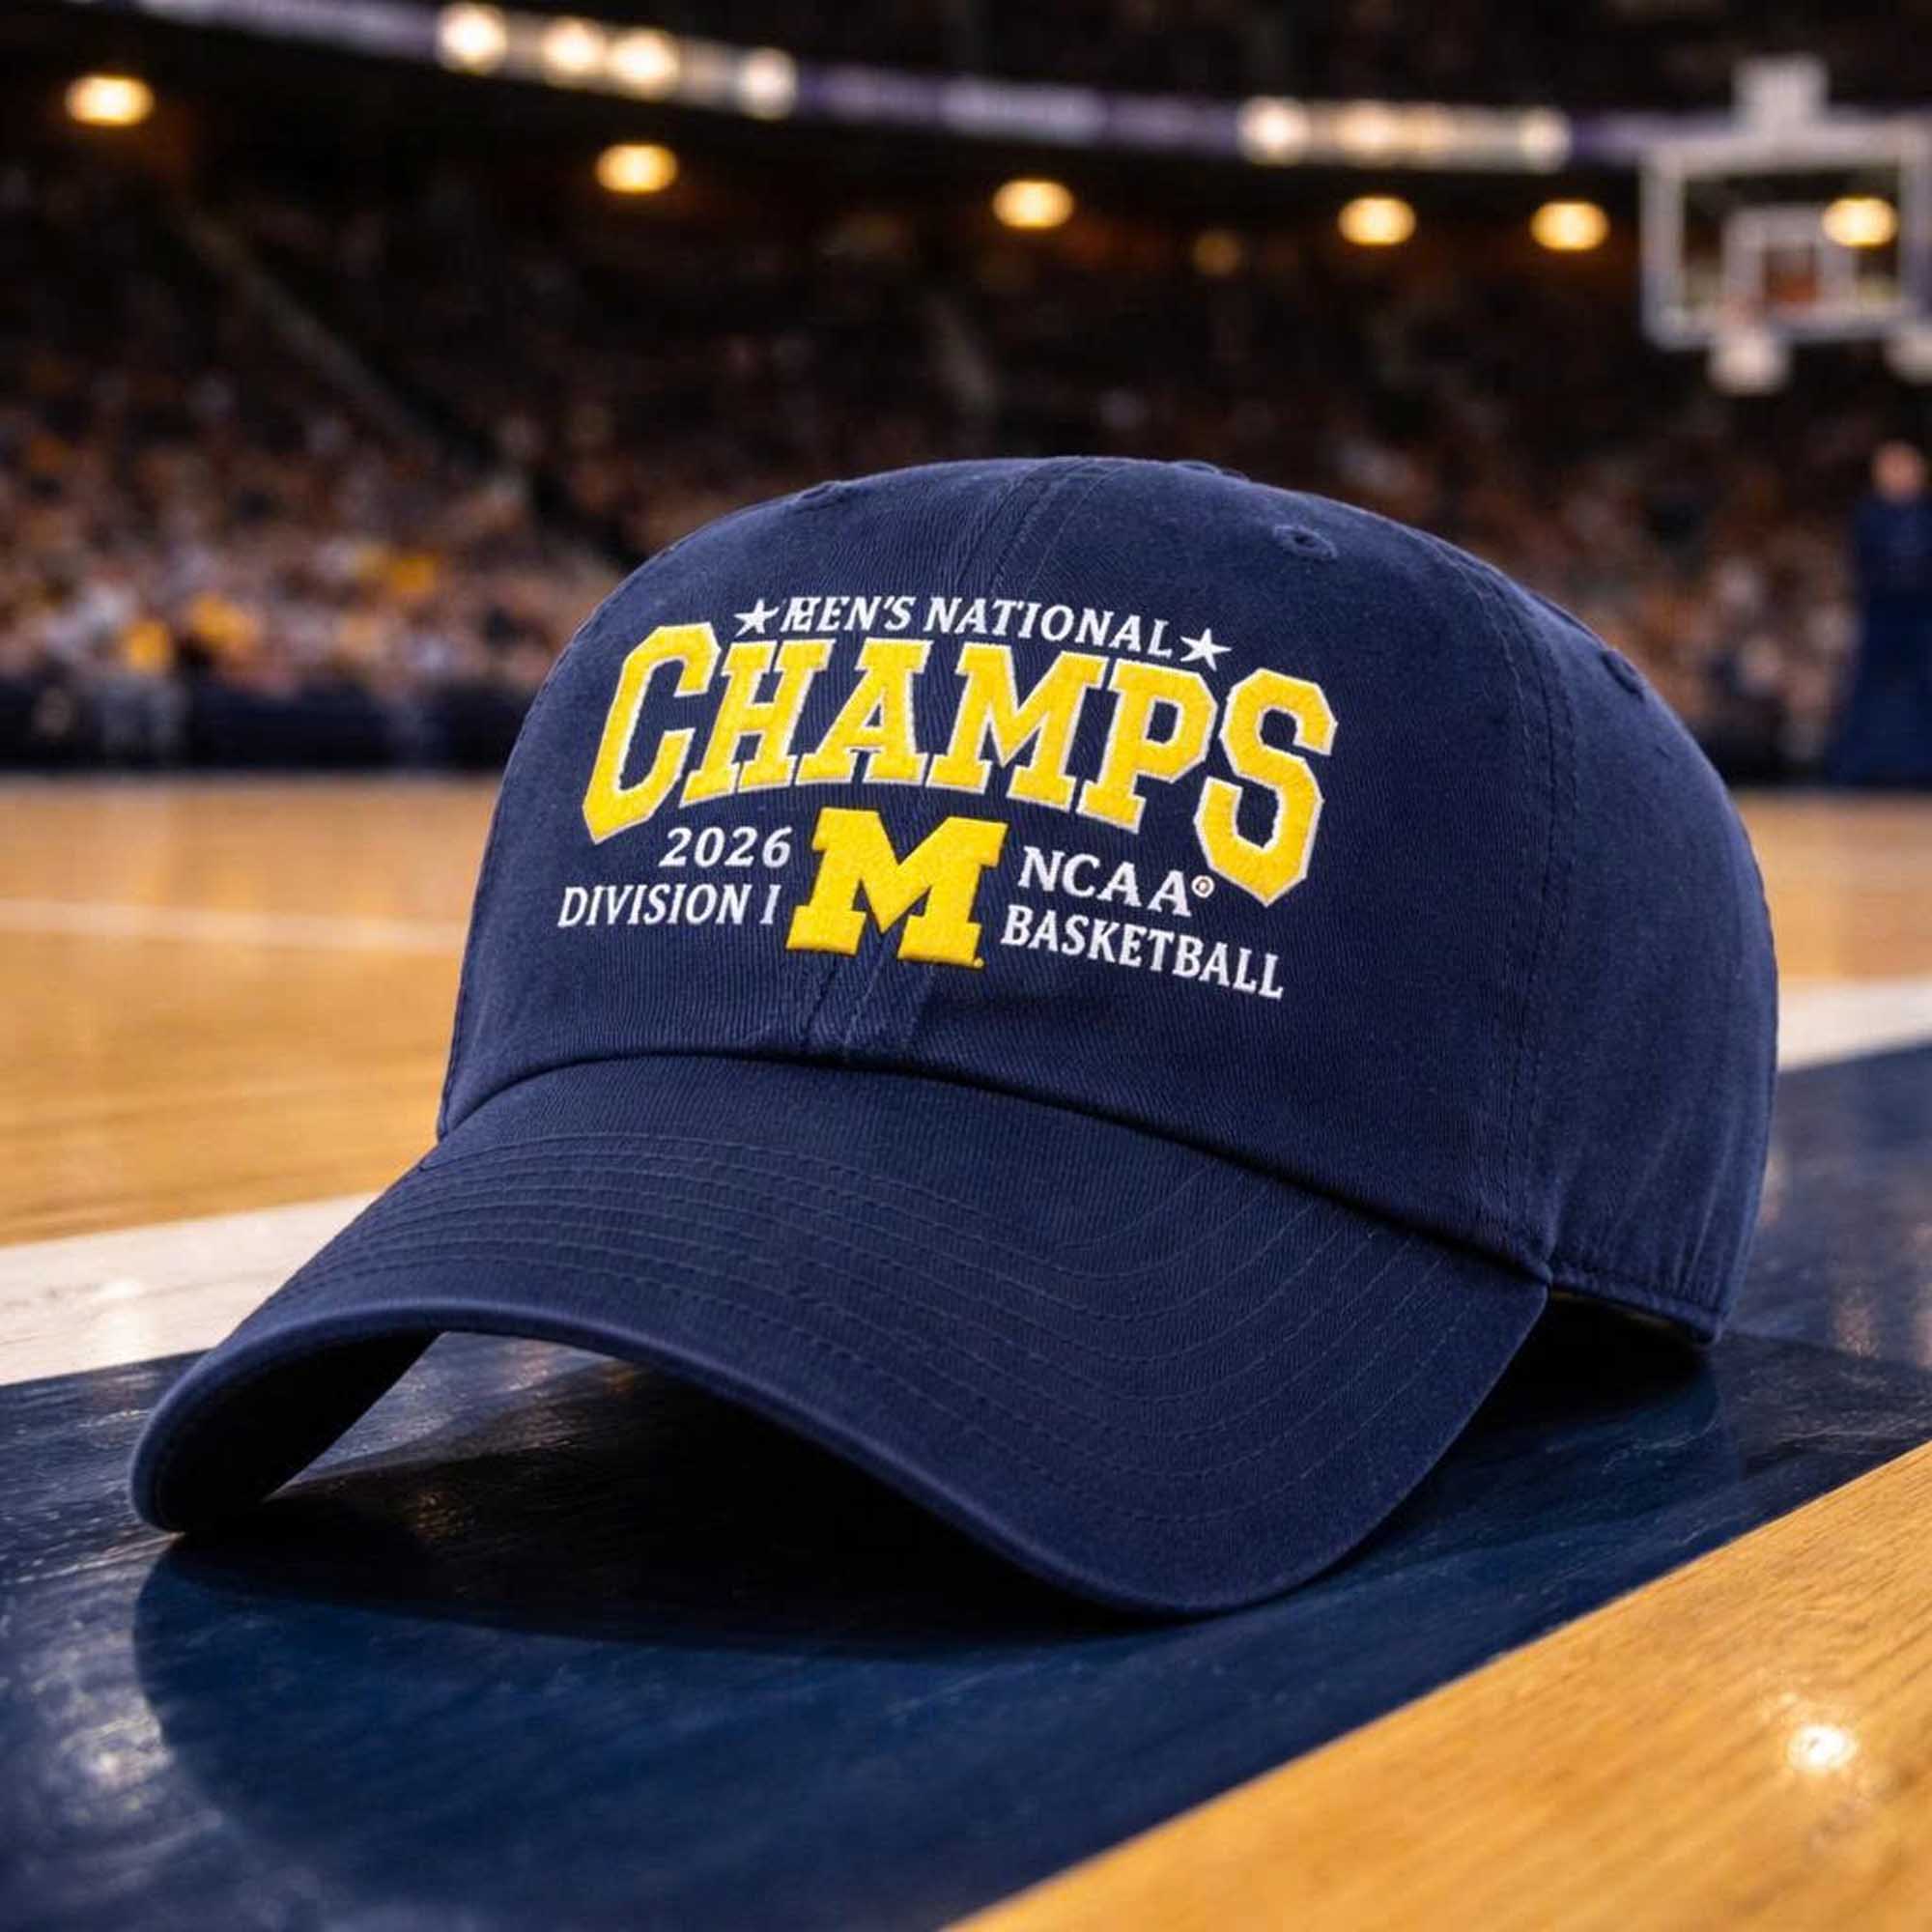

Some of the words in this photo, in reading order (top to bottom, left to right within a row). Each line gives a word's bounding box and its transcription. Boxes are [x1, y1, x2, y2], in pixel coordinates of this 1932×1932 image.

[926, 597, 1173, 659] NATIONAL
[582, 621, 1338, 906] CHAMPS
[659, 826, 793, 867] 2026
[557, 883, 753, 928] DIVISION
[759, 884, 781, 925] I
[1001, 904, 1284, 1000] BASKETBALL
